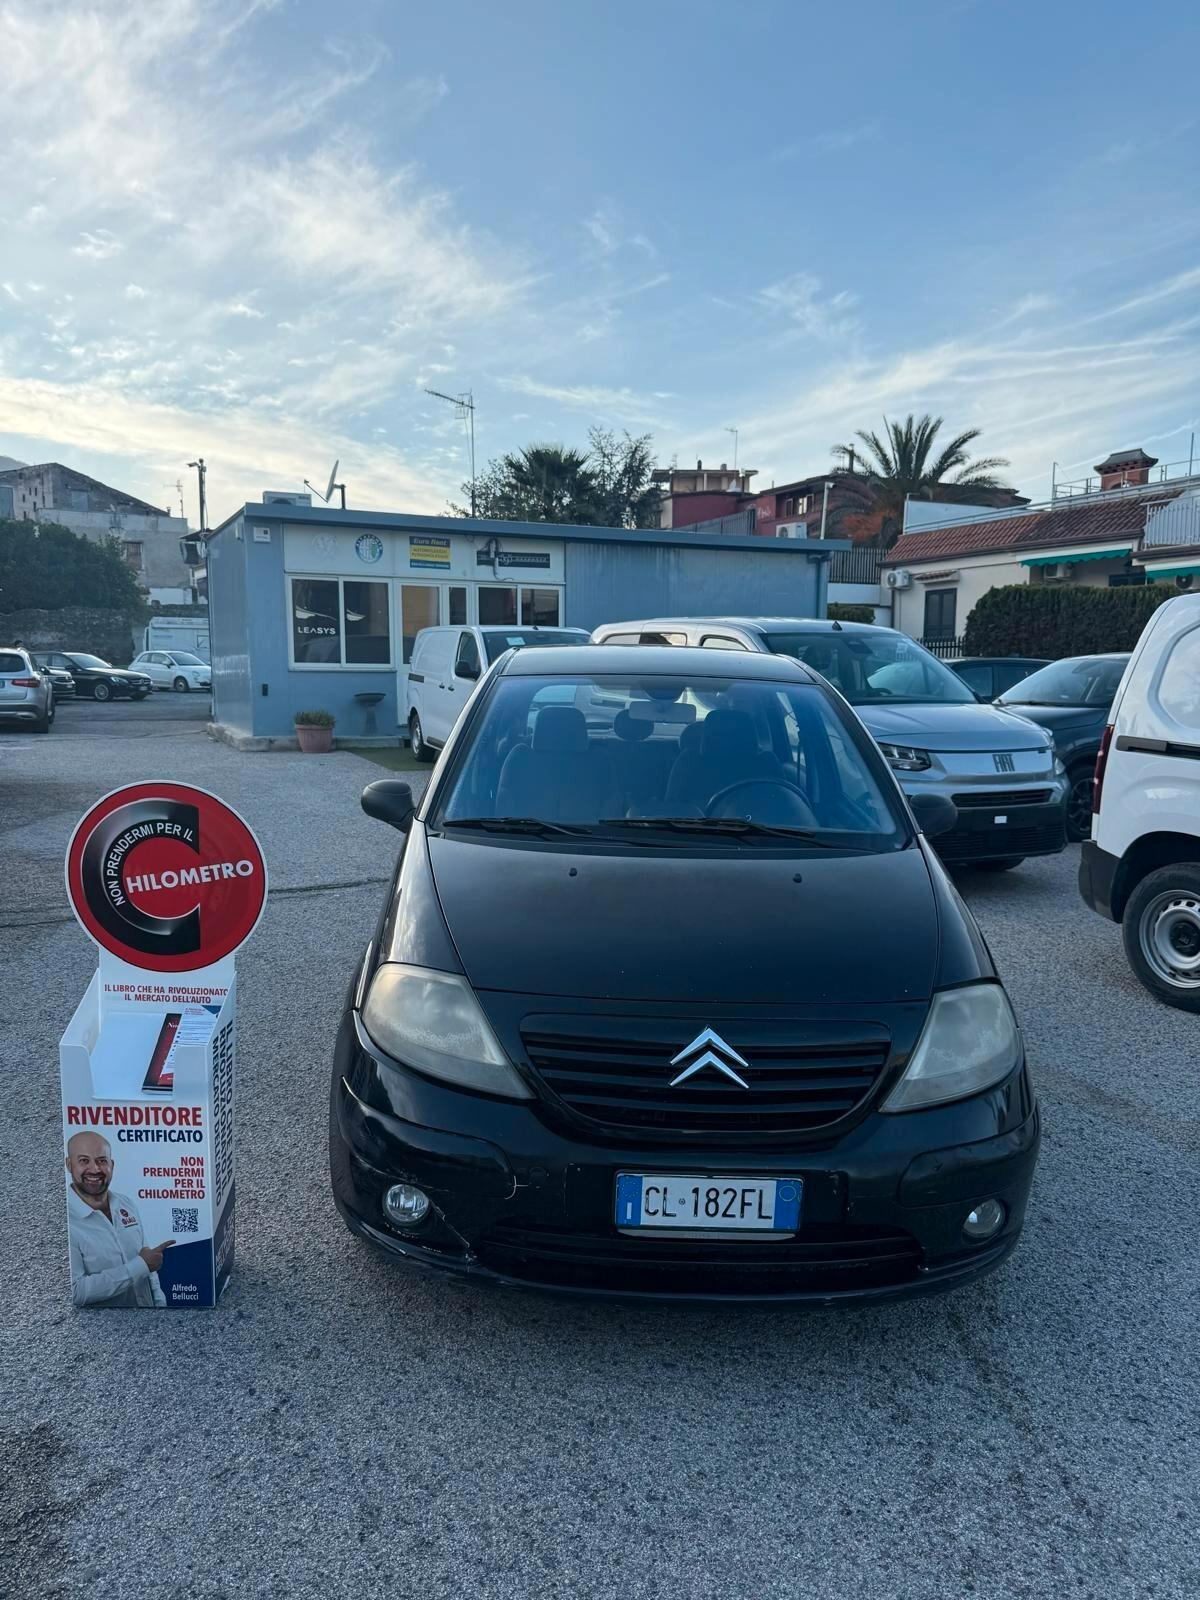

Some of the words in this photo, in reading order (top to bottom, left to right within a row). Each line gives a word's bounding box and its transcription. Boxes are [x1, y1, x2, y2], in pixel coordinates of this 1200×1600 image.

[992, 753, 1015, 773] FIAT
[157, 822, 182, 836] PER
[183, 827, 194, 842] IL
[107, 823, 154, 877] PRENDERMI
[109, 880, 125, 907] NON
[104, 984, 111, 992] IL
[113, 984, 136, 993] LIBRO
[137, 985, 152, 993] CHE
[154, 986, 165, 994] HA
[124, 993, 132, 1001] IL
[134, 994, 171, 1003] MERCATO
[172, 995, 211, 1004] DELL'AUTO
[67, 1105, 203, 1126] RIVENDITORE
[117, 1129, 203, 1143] CERTIFICATO
[180, 1156, 204, 1167] NON
[143, 1167, 205, 1178] PRENDERMI
[174, 1179, 193, 1188] PER
[196, 1179, 206, 1189] IL
[138, 1189, 205, 1200] CHILOMETRO
[171, 1283, 197, 1292] Alfredo
[172, 1292, 199, 1301] Bellucci
